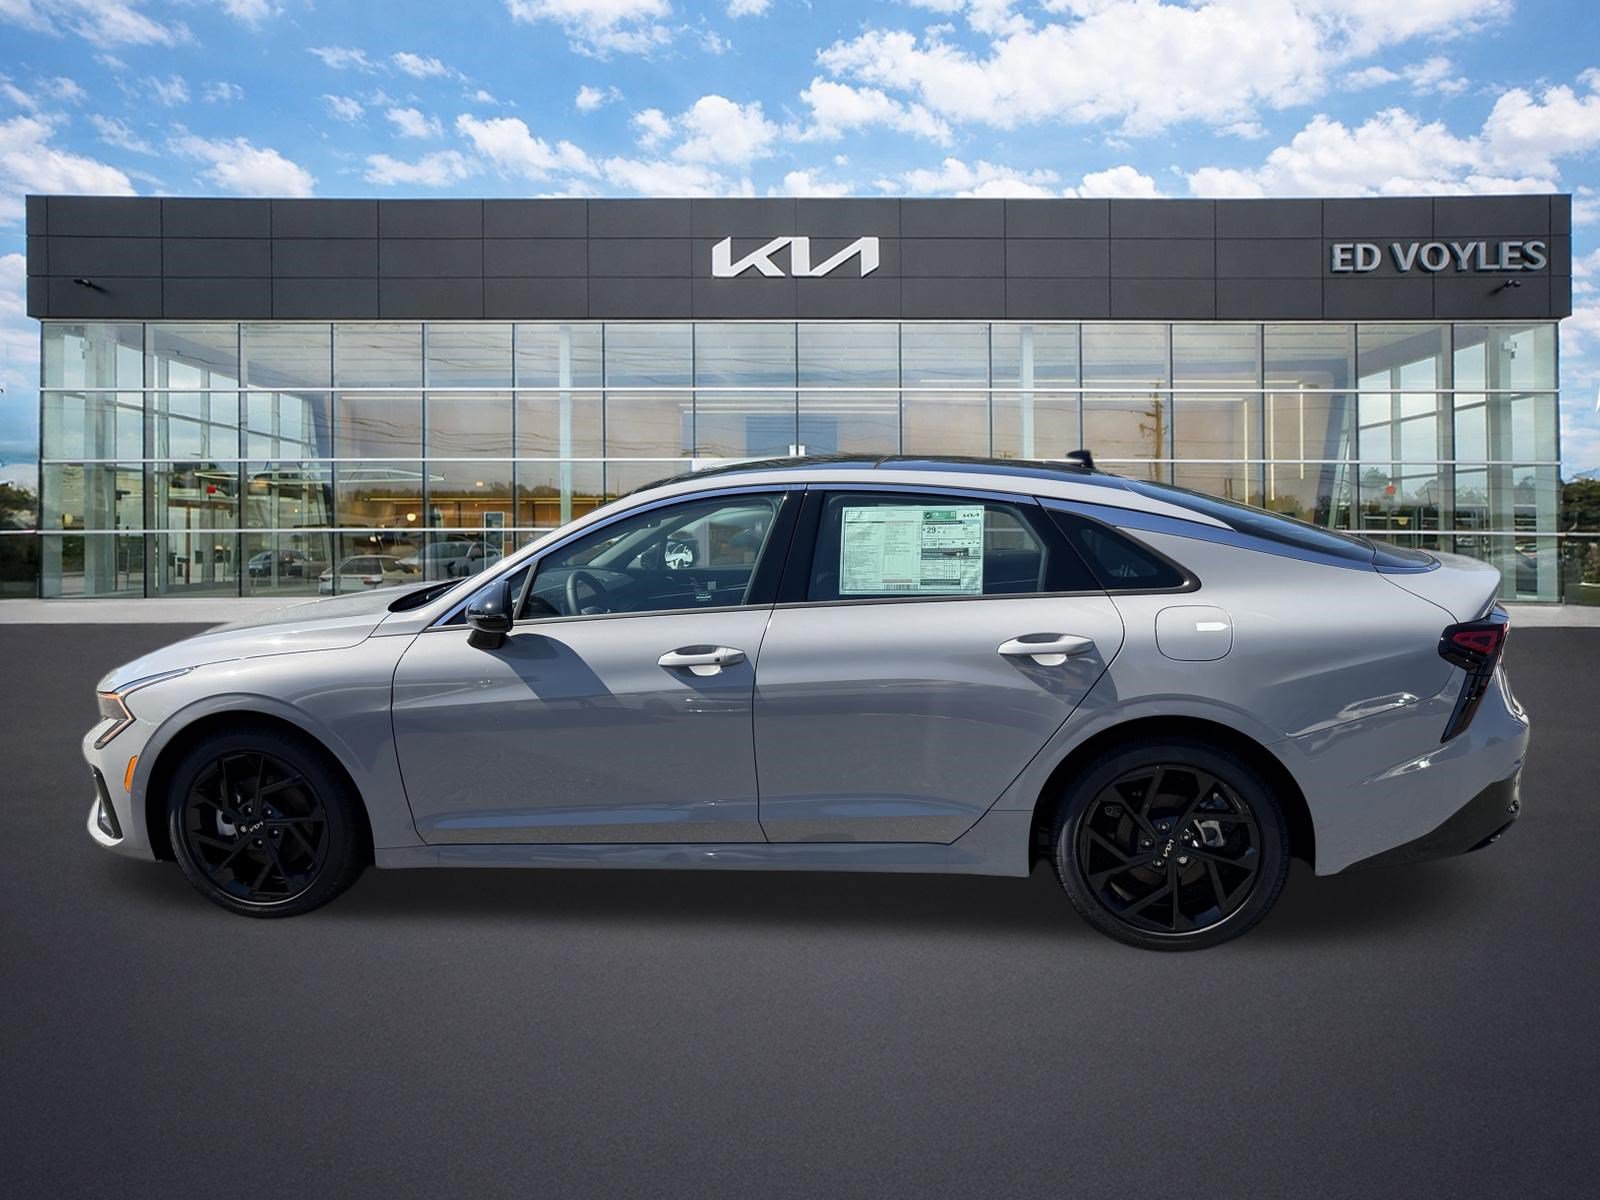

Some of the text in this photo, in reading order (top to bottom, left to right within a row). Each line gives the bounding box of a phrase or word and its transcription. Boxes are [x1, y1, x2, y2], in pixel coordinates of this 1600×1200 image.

[712, 236, 880, 278] KIA
[1332, 240, 1548, 273] ED VOYLES
